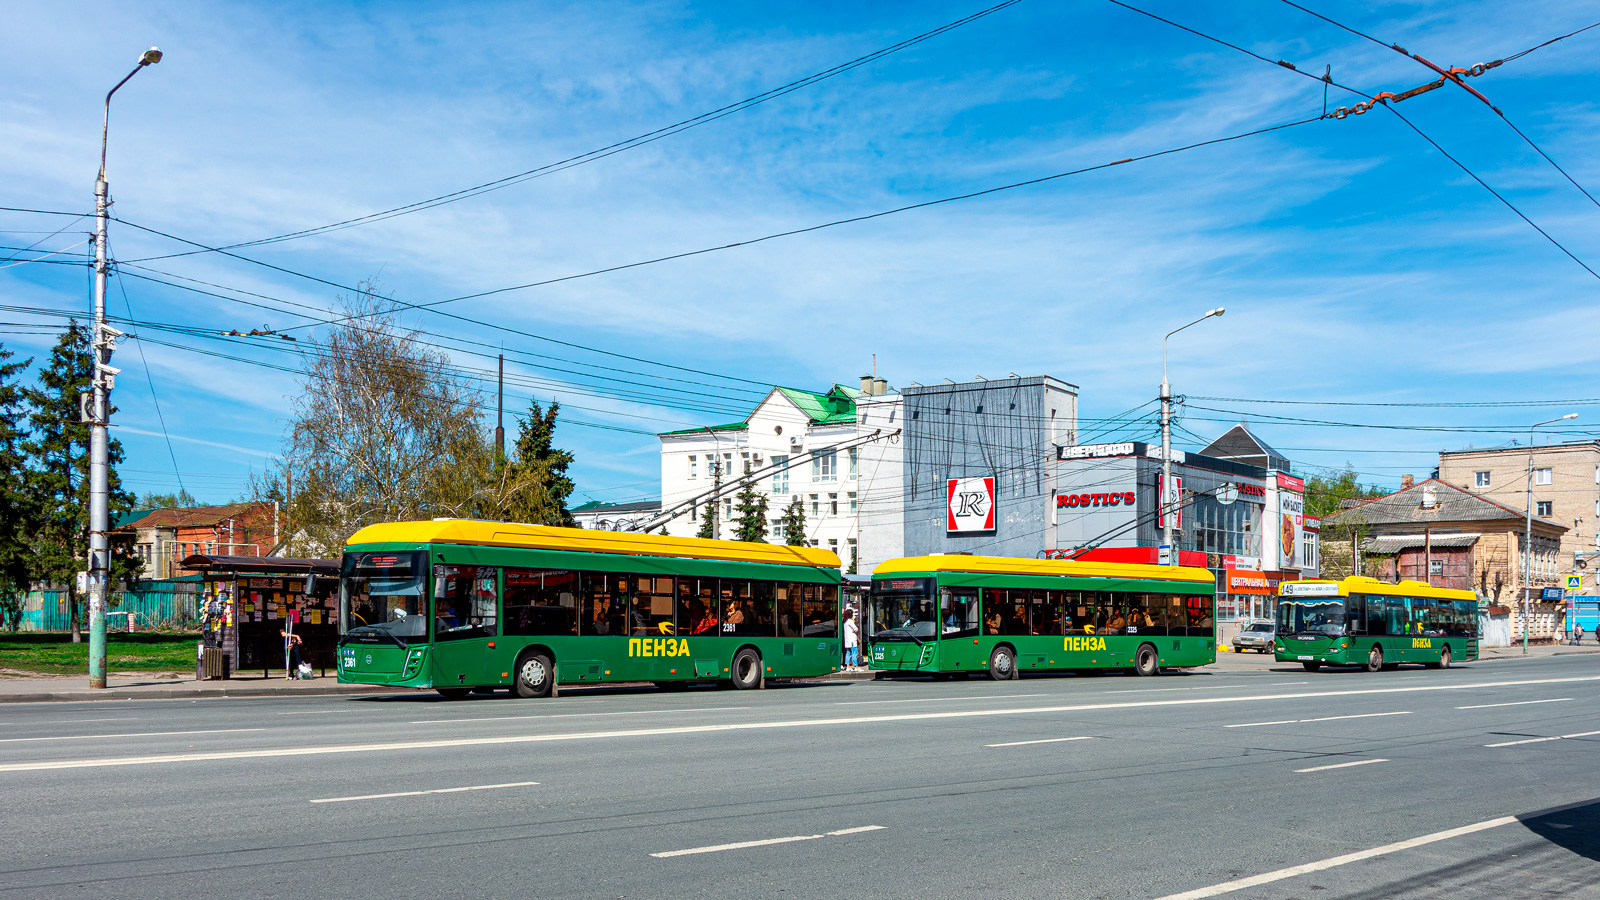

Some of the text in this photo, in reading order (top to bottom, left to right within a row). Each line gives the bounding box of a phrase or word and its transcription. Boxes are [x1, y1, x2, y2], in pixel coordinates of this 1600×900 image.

[956, 492, 985, 517] R
[1057, 492, 1136, 508] ROSTIC'S
[1231, 577, 1264, 587] ЦЕНТРАЛЬНАЯ
[1282, 585, 1294, 595] 149
[723, 623, 736, 632] 2361
[628, 638, 690, 657] ПЕНЗА
[1063, 637, 1107, 651] ПЕНЗА
[1412, 637, 1431, 648] ПЕНЗА
[344, 657, 356, 668] 2361
